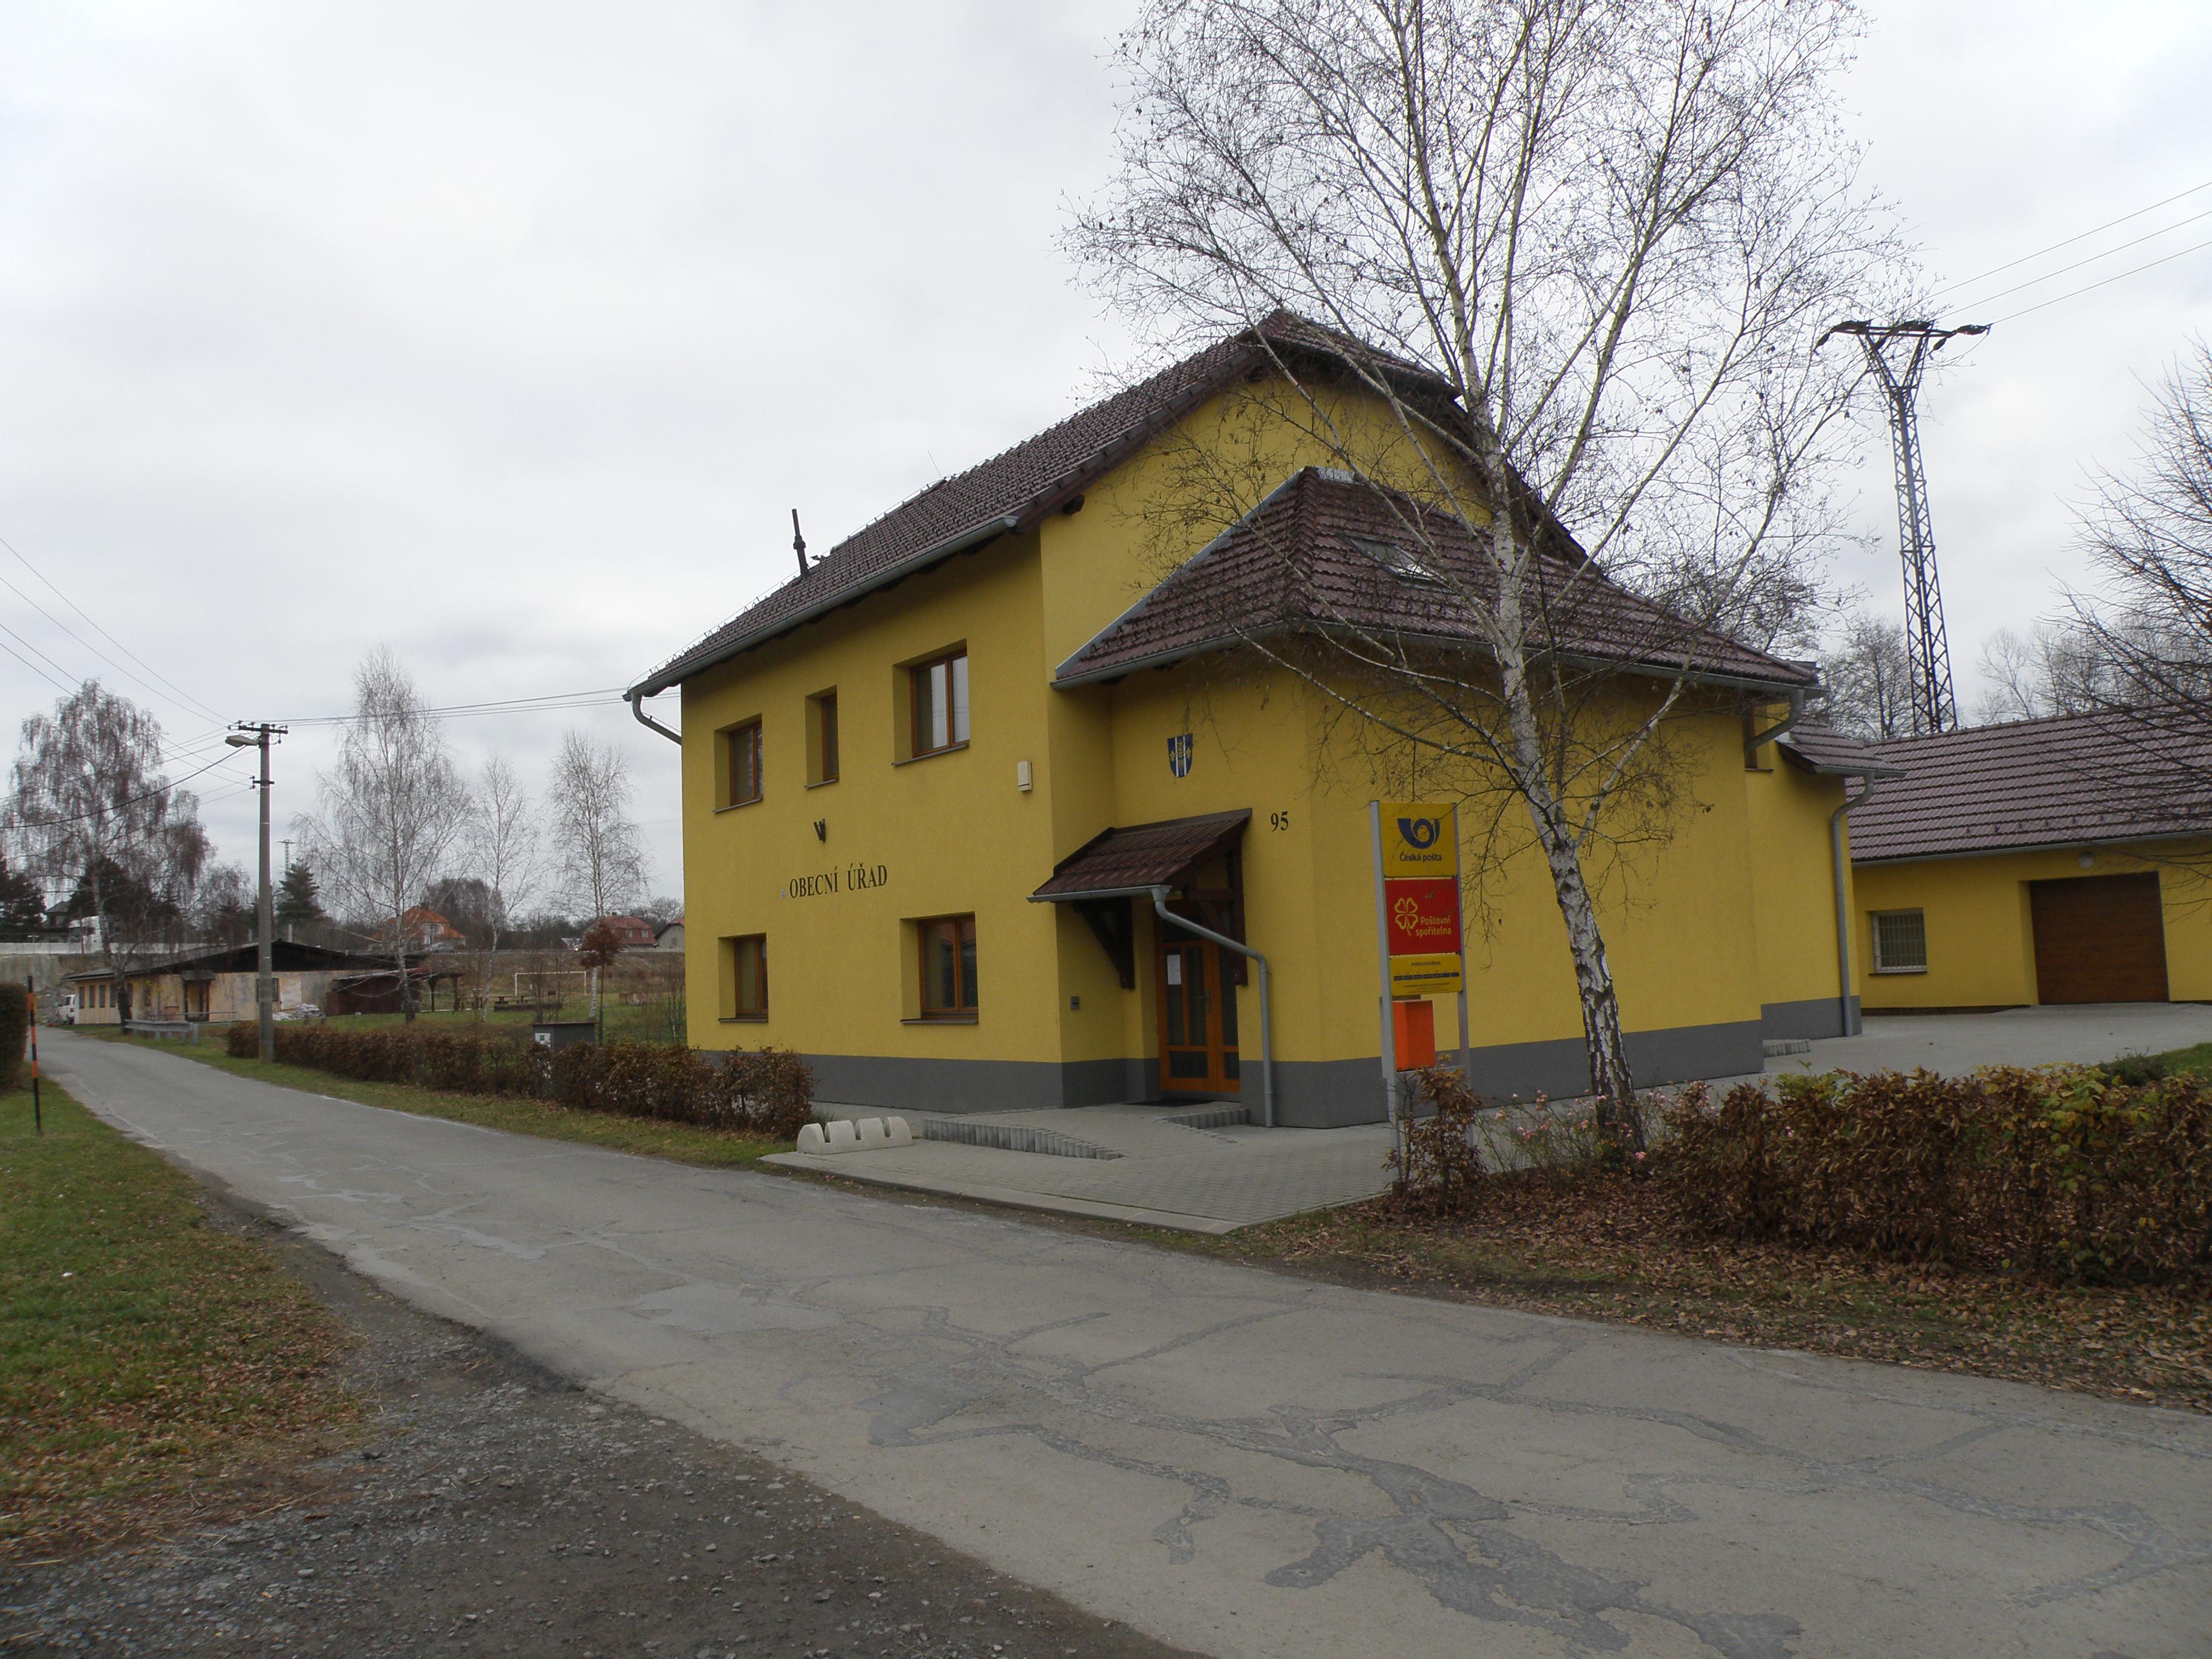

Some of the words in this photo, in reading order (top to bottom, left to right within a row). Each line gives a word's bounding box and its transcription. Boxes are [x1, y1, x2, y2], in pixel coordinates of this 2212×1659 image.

[1270, 811, 1289, 832] 95
[1399, 850, 1421, 861] Česká
[1423, 853, 1443, 862] pošta
[789, 866, 839, 898] OBECNÍ
[847, 862, 887, 891] ÚŘAD
[1420, 915, 1450, 925] Poštovní
[1415, 926, 1452, 938] spořitelna
